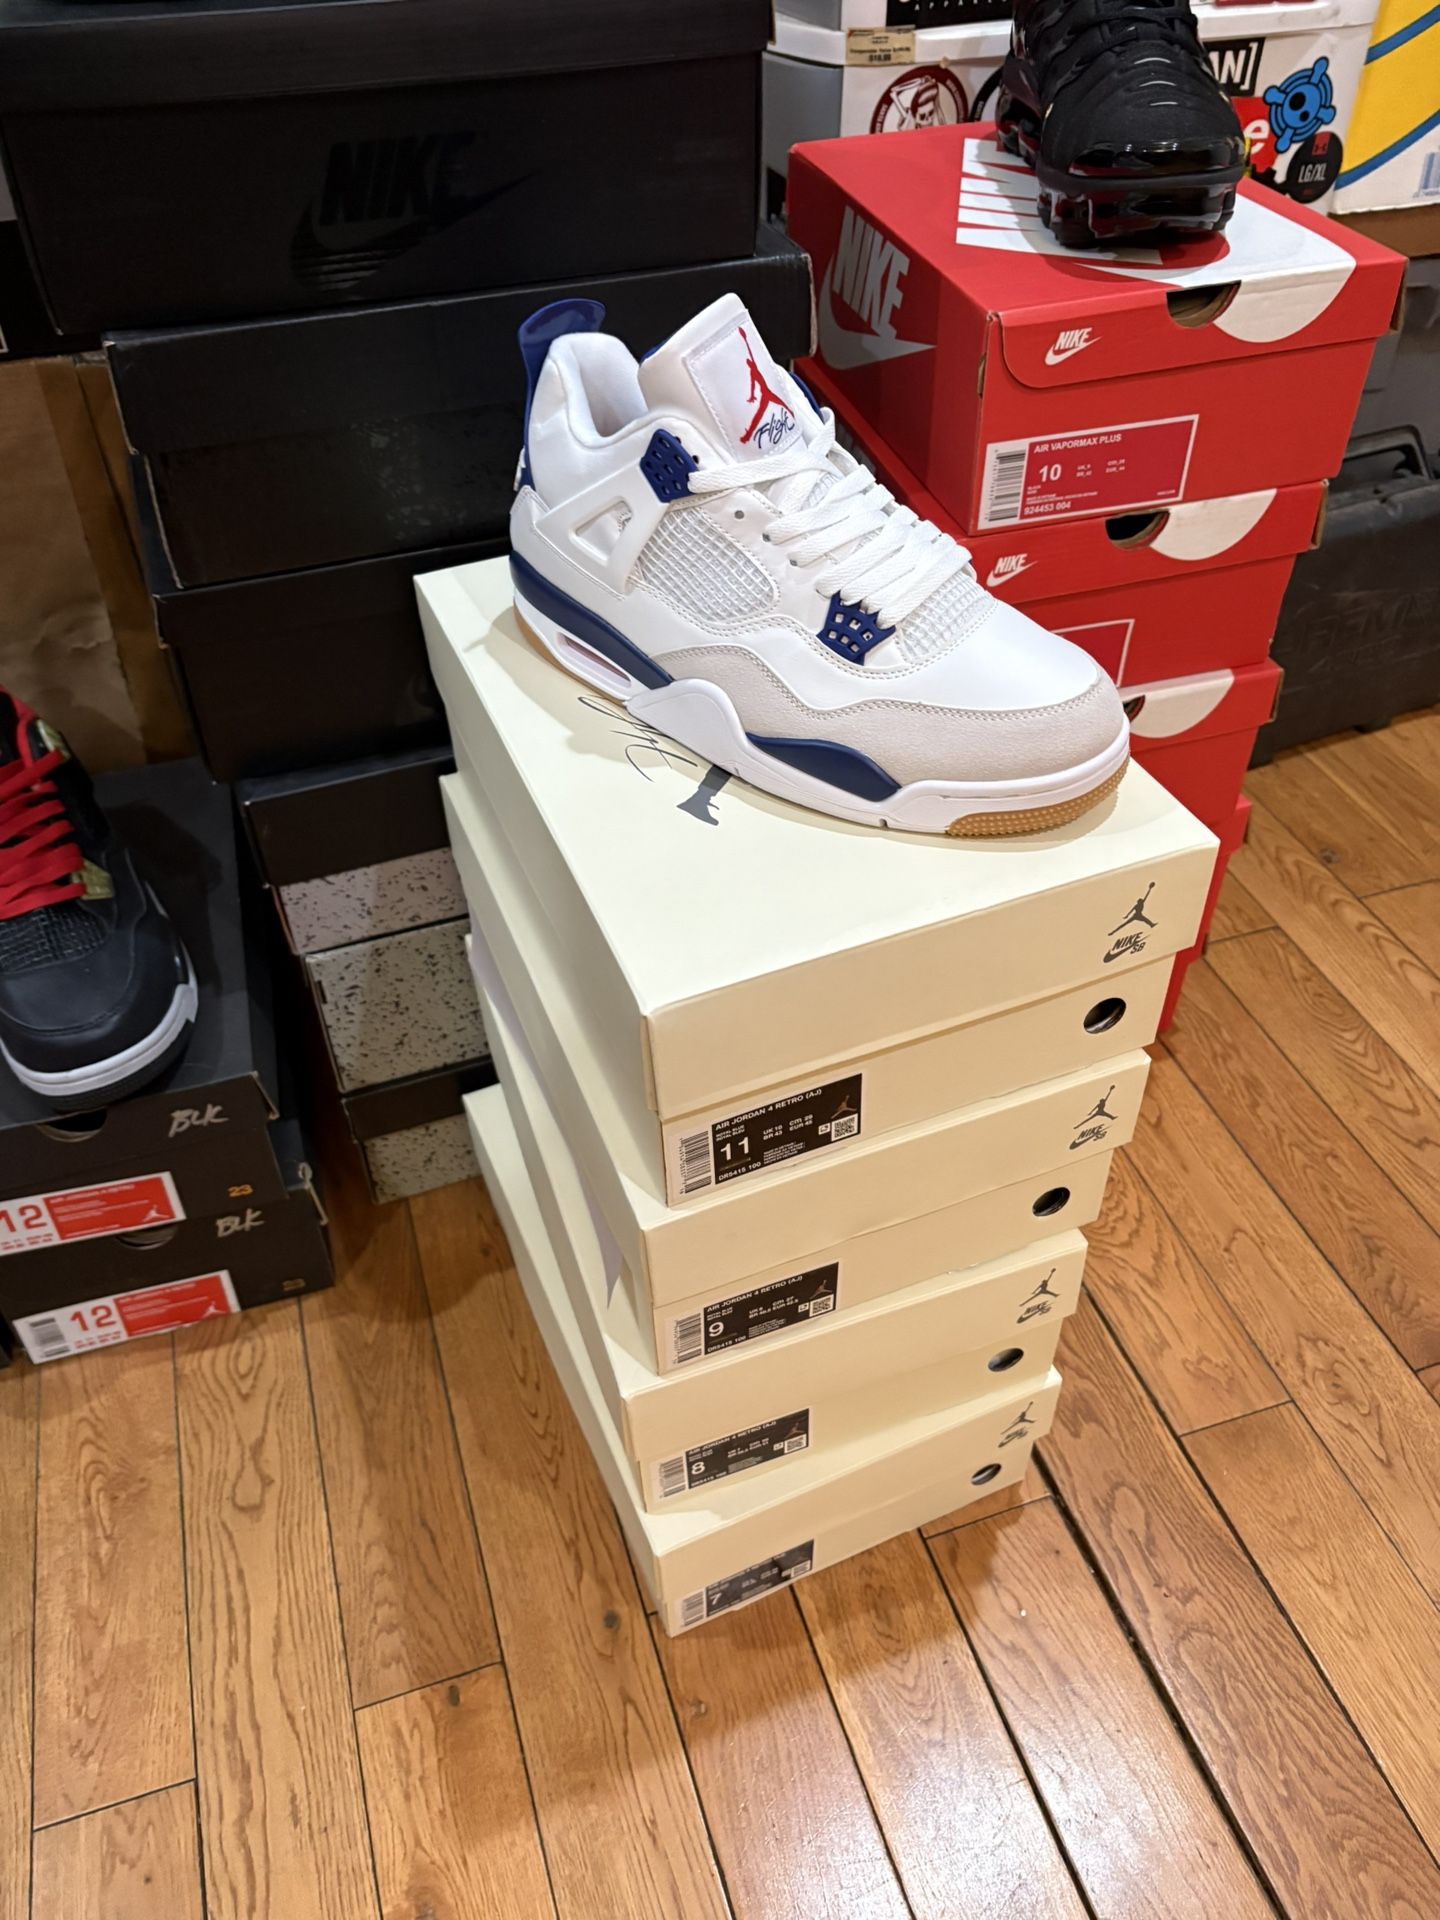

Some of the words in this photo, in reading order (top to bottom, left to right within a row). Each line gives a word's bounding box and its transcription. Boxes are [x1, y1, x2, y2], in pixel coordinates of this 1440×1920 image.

[318, 130, 477, 226] NIKE
[1297, 162, 1327, 183] LG/XL
[832, 205, 910, 340] NIKE
[1055, 327, 1093, 350] NIKE
[753, 408, 795, 449] Flight
[1034, 443, 1049, 454] AIR
[1051, 437, 1098, 450] VAPORMAX
[1099, 433, 1122, 444] PLUS
[1039, 464, 1062, 482] 10
[1024, 503, 1054, 515] 924453
[994, 553, 1028, 574] NIKE
[1112, 931, 1143, 951] NIKE
[1130, 942, 1146, 954] SB
[715, 1121, 730, 1131] AIR
[731, 1108, 766, 1125] JORDAN
[775, 1095, 804, 1109] RETRO
[805, 1088, 822, 1099] (AJ)
[763, 1127, 774, 1135] UK
[789, 1123, 804, 1131] EUR
[1077, 1123, 1104, 1140] NIKE
[720, 1136, 749, 1161] 11
[718, 1167, 747, 1181] DR5415
[748, 1161, 762, 1170] 100
[227, 1184, 254, 1198] 23
[0, 1204, 48, 1233] 12
[216, 1207, 265, 1238] BLK
[707, 1303, 720, 1312] AIR
[721, 1292, 753, 1308] JORDAN
[760, 1282, 787, 1294] RETRO
[70, 1305, 117, 1332] 12
[708, 1321, 724, 1337] 9
[691, 1461, 706, 1475] 8
[709, 1592, 723, 1606] 7
